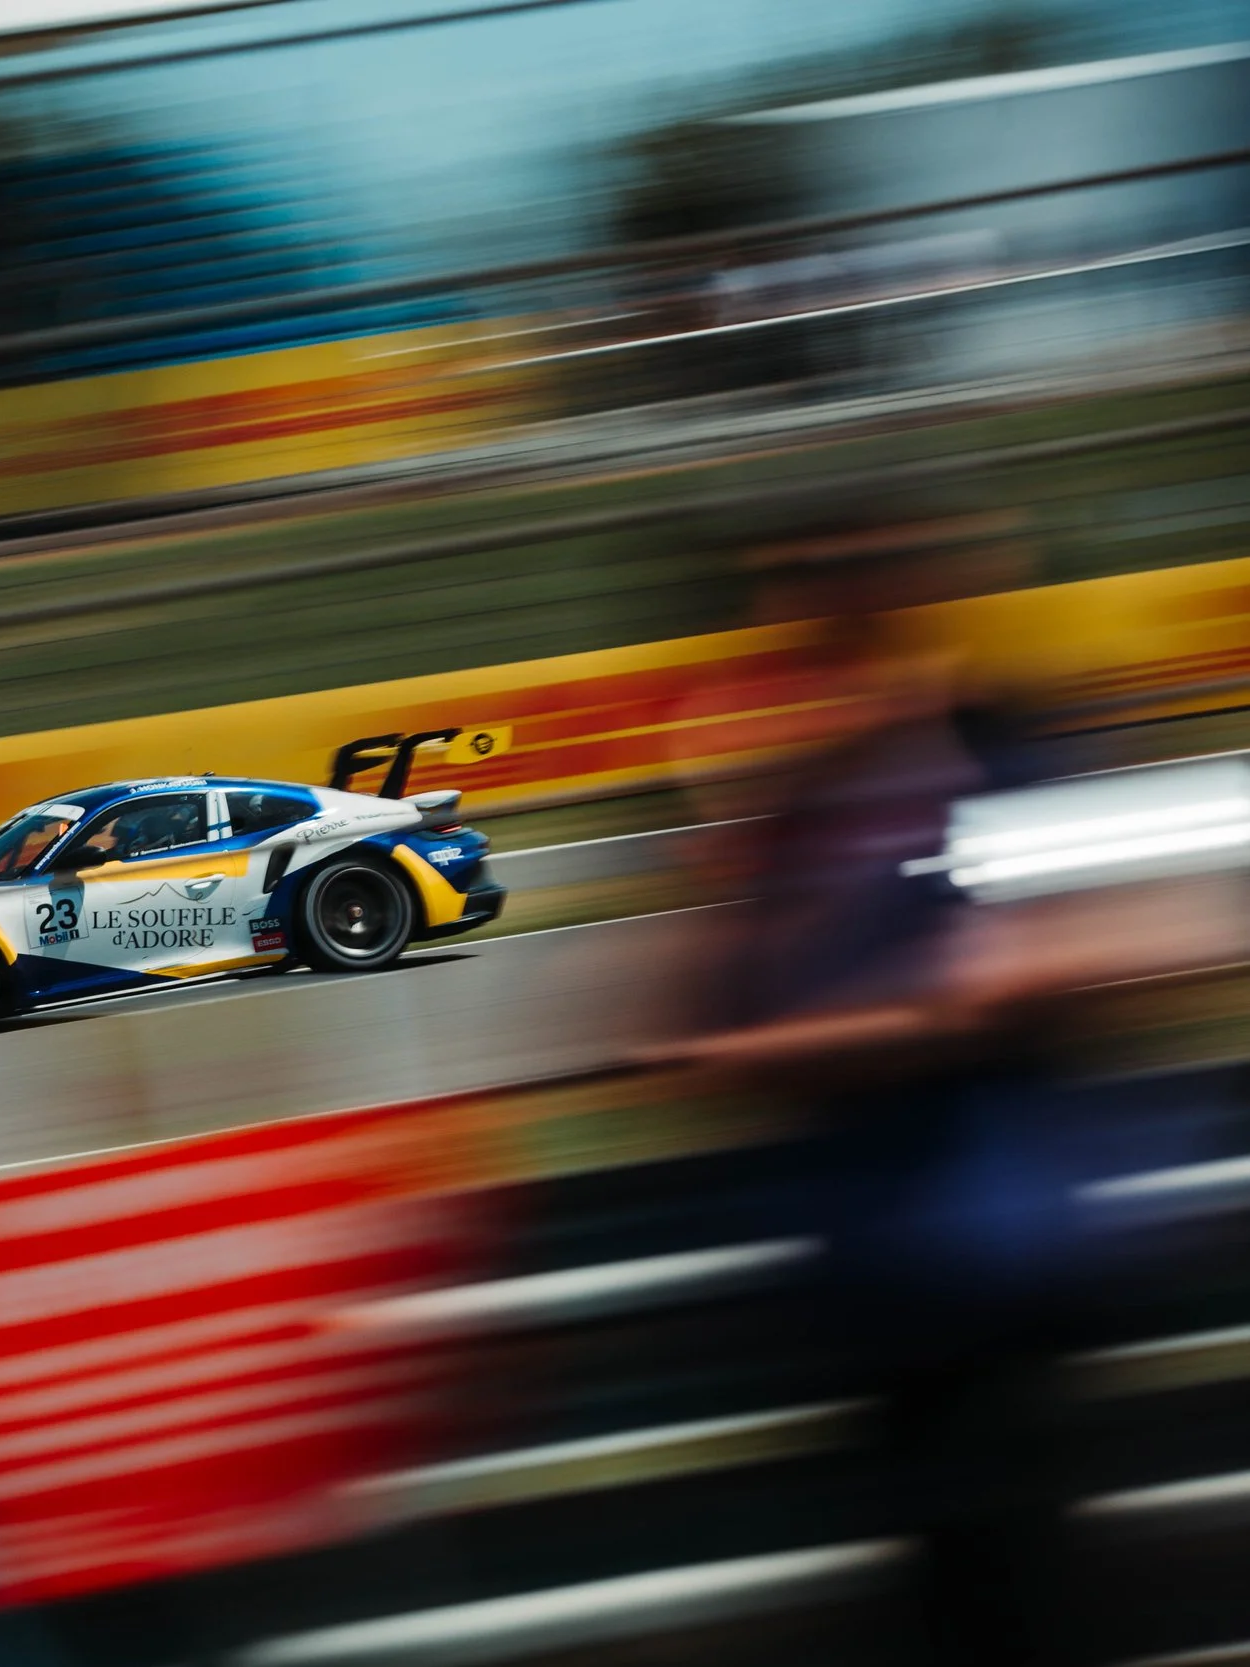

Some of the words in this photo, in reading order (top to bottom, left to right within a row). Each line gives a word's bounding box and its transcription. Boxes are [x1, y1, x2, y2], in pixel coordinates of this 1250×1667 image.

[296, 819, 350, 844] Pierre
[36, 898, 78, 934] 23
[92, 910, 122, 929] LE
[128, 907, 237, 928] SOUFFLE
[252, 918, 280, 930] BOSS
[39, 930, 68, 946] Mobil
[112, 928, 214, 949] d'ADORE
